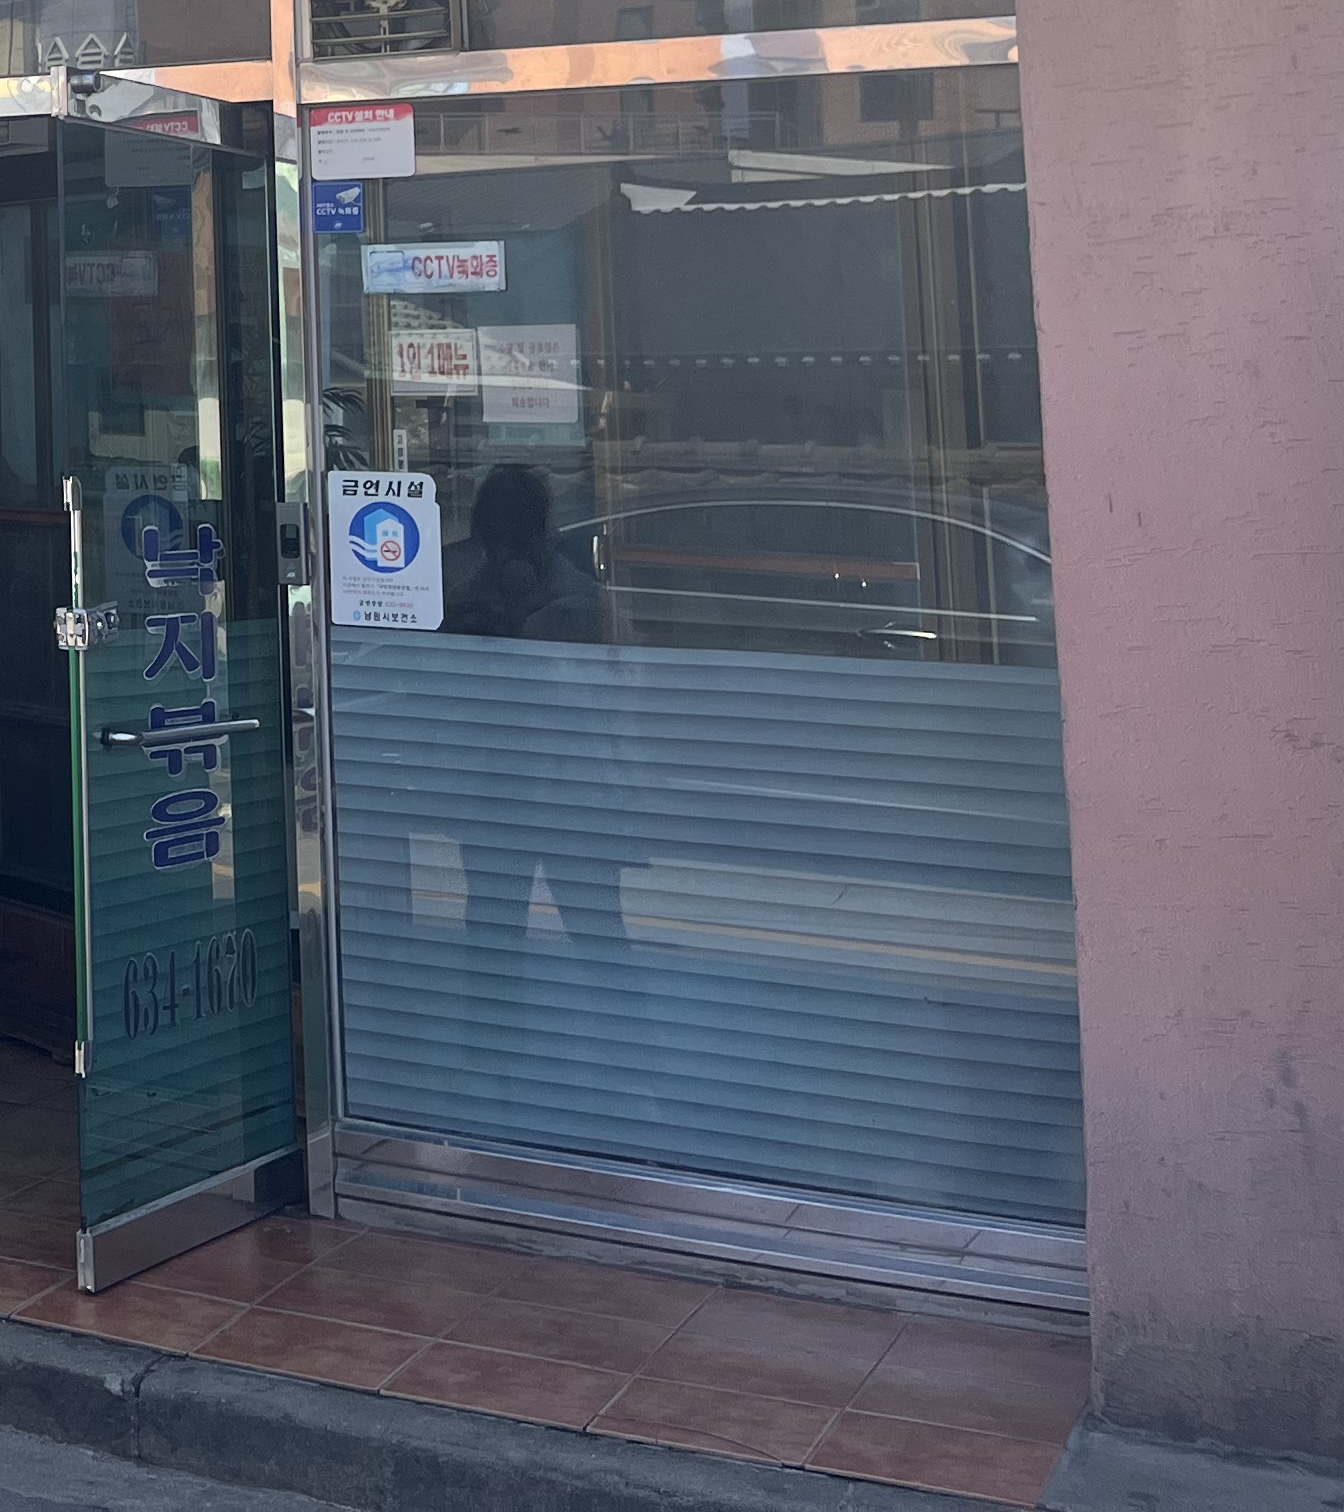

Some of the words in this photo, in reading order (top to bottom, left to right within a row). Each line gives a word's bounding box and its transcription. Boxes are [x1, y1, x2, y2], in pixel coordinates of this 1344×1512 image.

[412, 253, 498, 280] CCTV녹화중
[342, 479, 424, 499] 금연시설
[364, 611, 418, 624] 남원시보건소
[122, 928, 260, 1041] 634-1670
